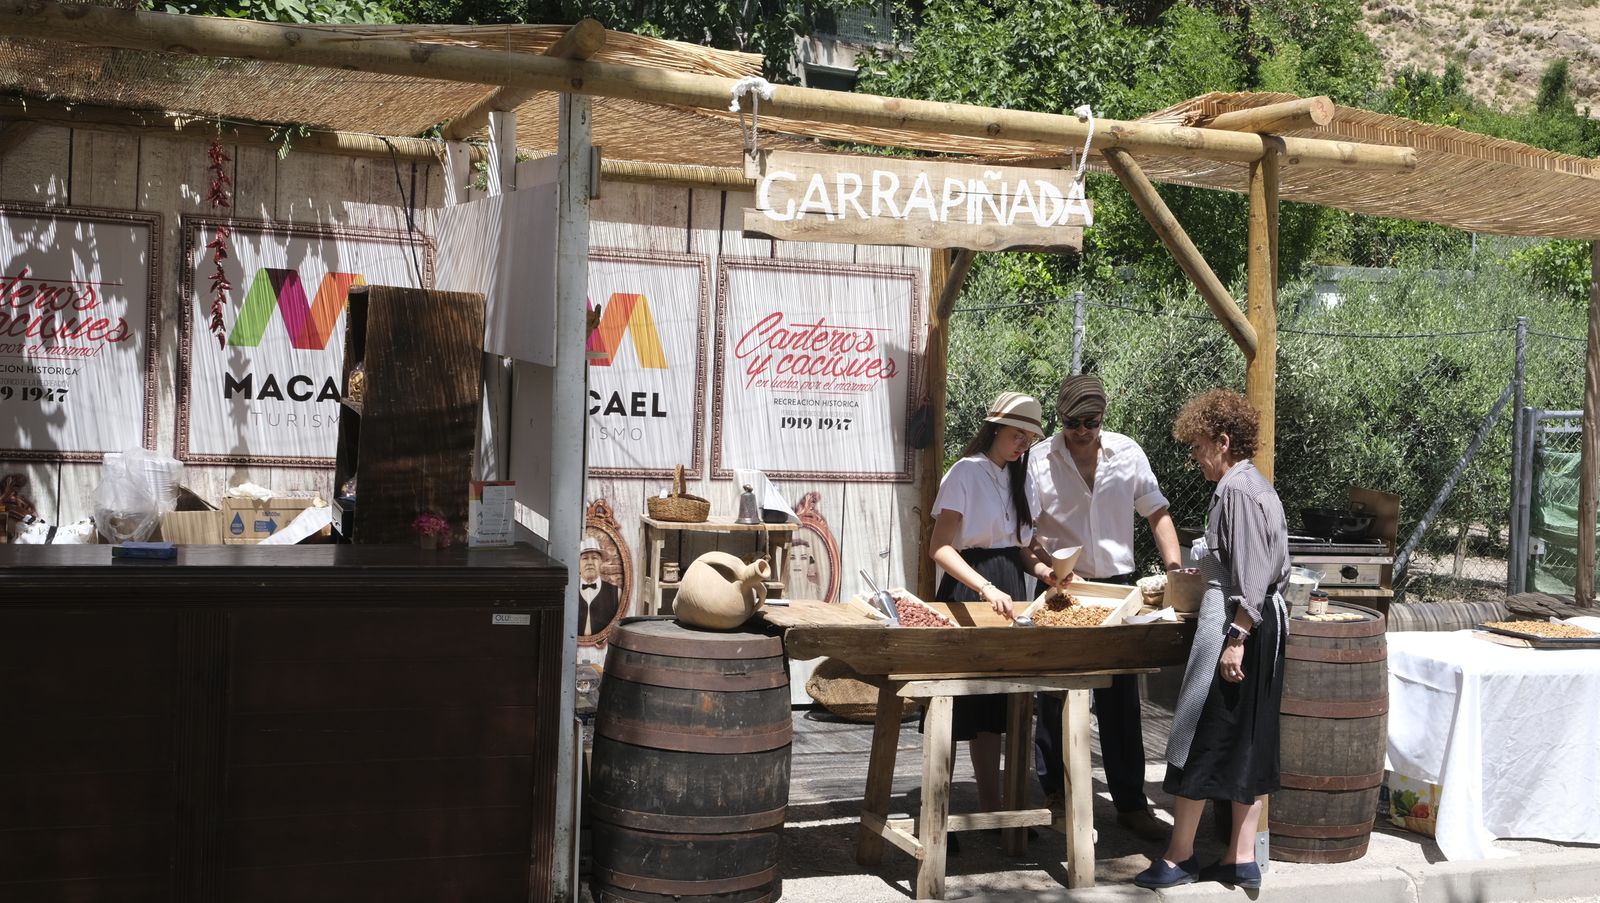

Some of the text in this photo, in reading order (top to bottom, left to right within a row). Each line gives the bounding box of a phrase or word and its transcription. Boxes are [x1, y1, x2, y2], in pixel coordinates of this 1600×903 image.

[759, 170, 1093, 228] GARRAPIÑADA
[735, 312, 878, 358] Canteros
[28, 339, 46, 355] el
[746, 352, 899, 390] y caciques
[0, 386, 68, 402] 9 1947
[224, 372, 341, 403] MACA
[755, 379, 768, 388] en
[797, 380, 821, 393] por
[823, 379, 835, 391] el
[251, 412, 341, 428] TURISM
[781, 417, 852, 431] 1919 1947
[591, 427, 643, 441] ISMO
